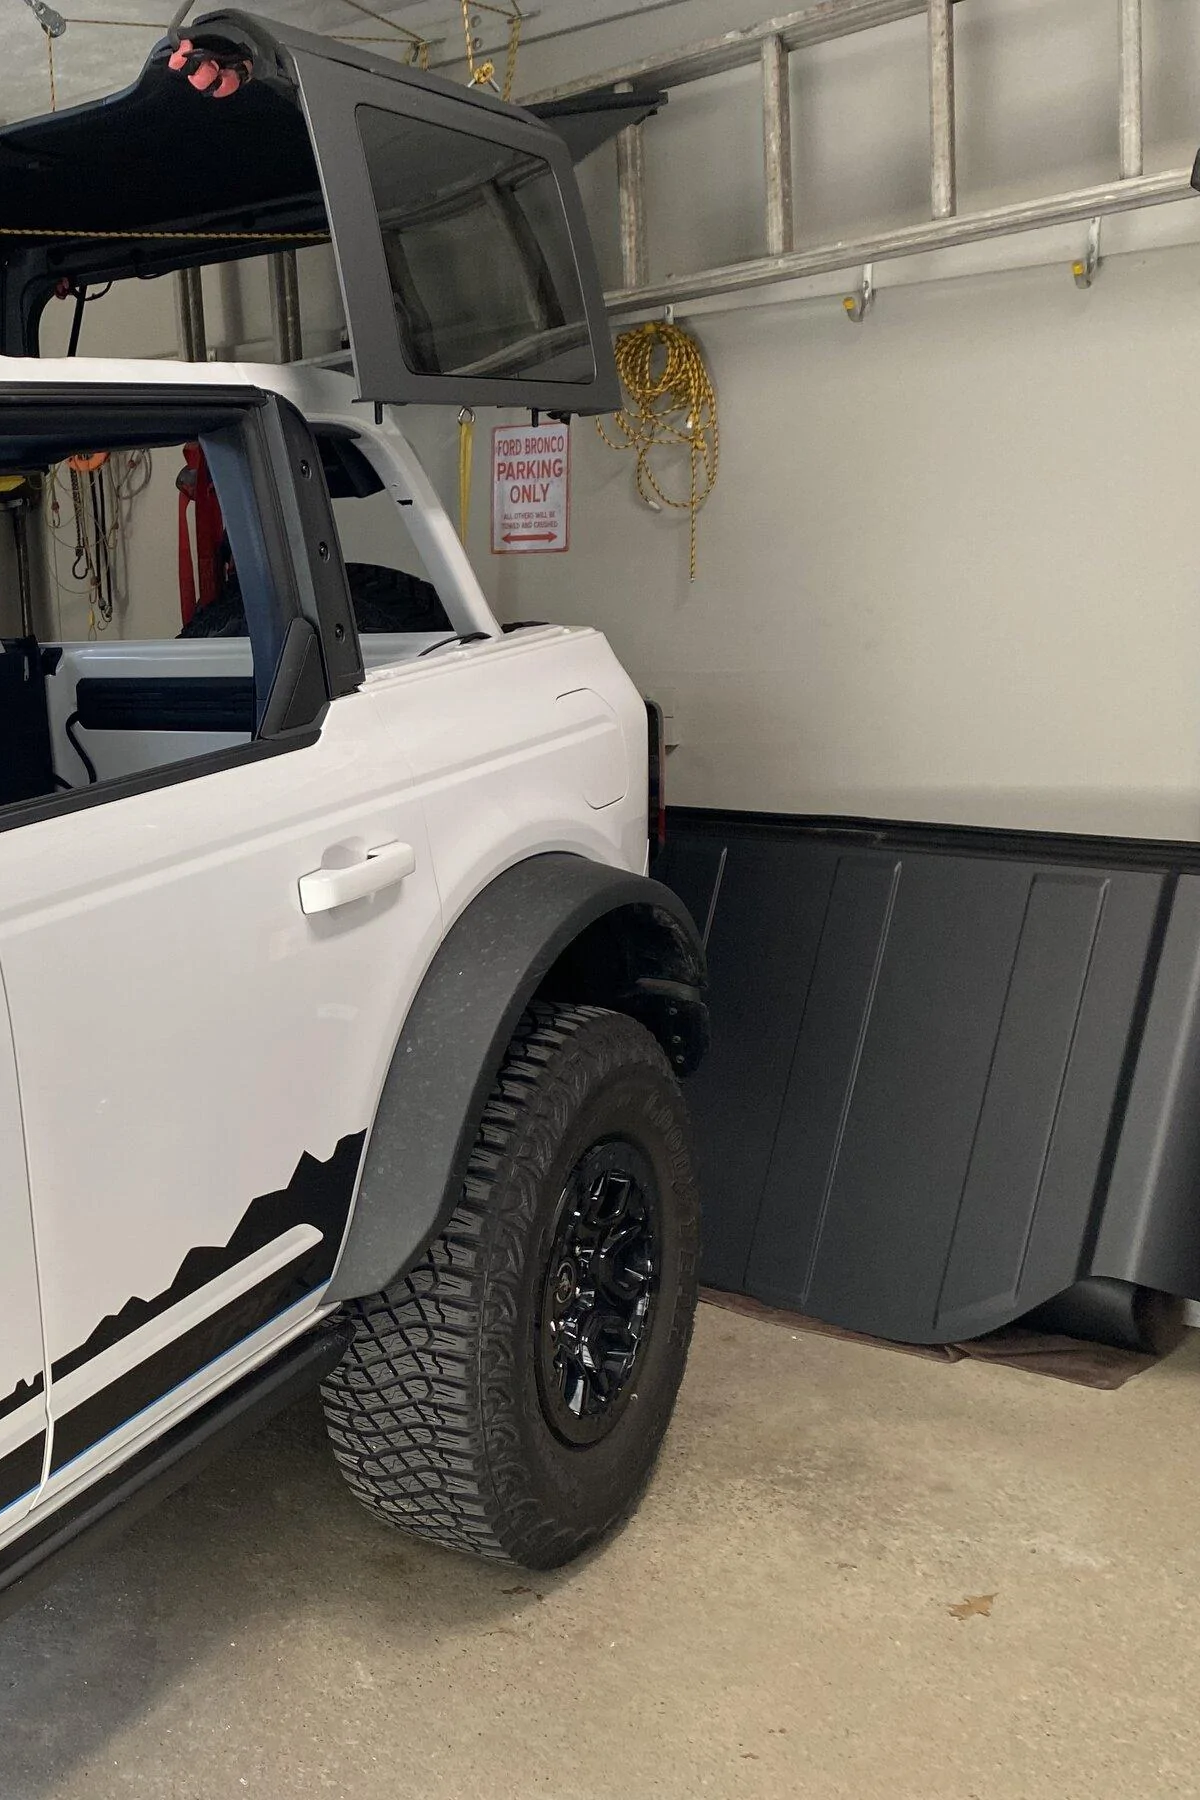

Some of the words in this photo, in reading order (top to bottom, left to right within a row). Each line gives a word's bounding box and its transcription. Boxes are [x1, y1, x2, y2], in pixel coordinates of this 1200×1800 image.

[497, 439, 522, 457] FORD
[525, 435, 564, 455] BRONCO
[497, 458, 563, 481] PARKING
[510, 483, 550, 504] ONLY
[503, 512, 513, 520] ALL
